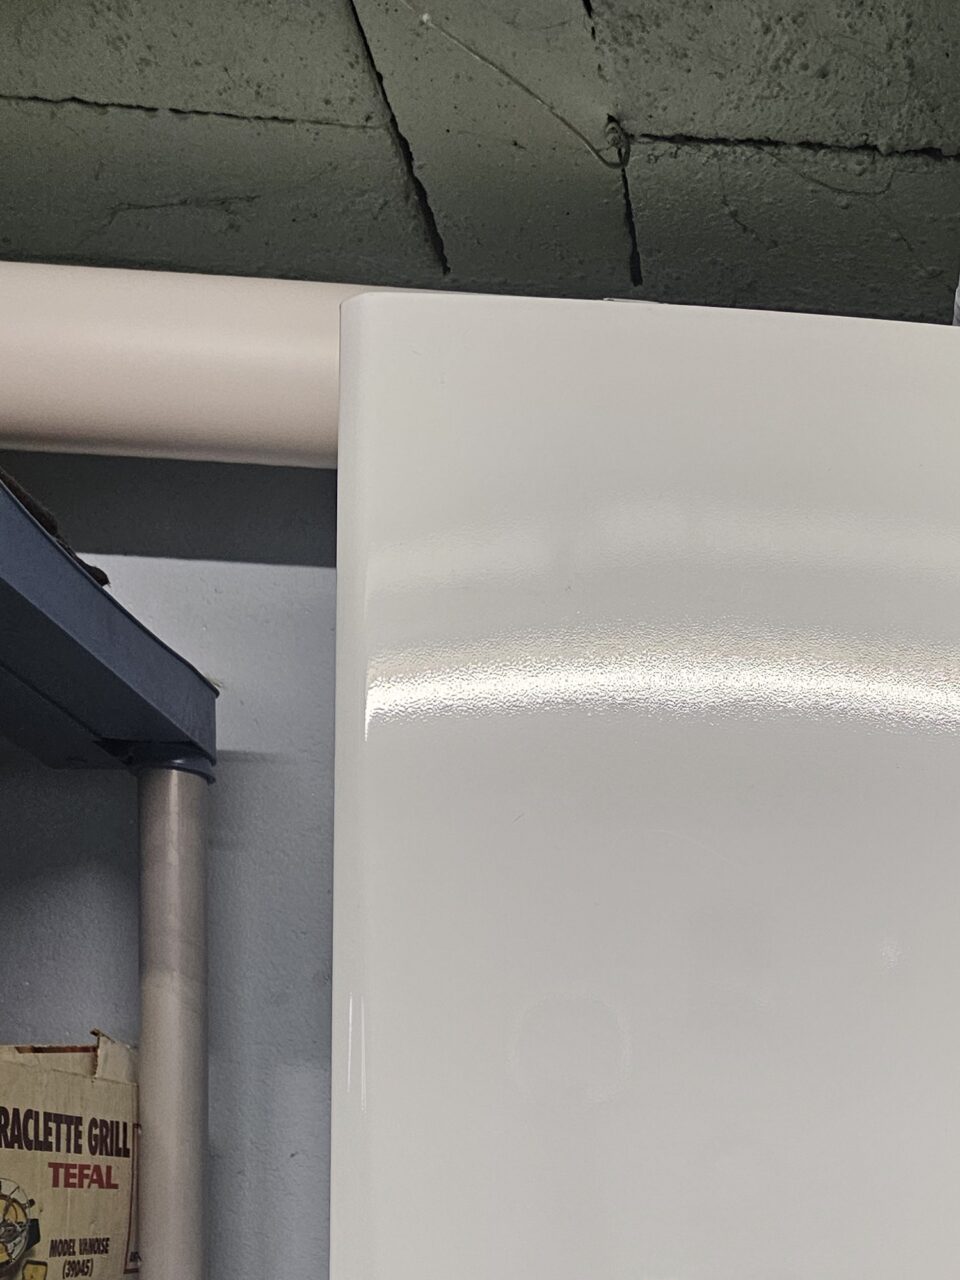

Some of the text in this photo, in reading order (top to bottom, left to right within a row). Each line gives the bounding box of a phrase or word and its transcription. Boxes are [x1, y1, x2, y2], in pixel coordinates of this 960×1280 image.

[0, 1106, 131, 1158] RACLETTE GRILL
[48, 1162, 119, 1189] TEFAL
[49, 1239, 76, 1258] MODEL
